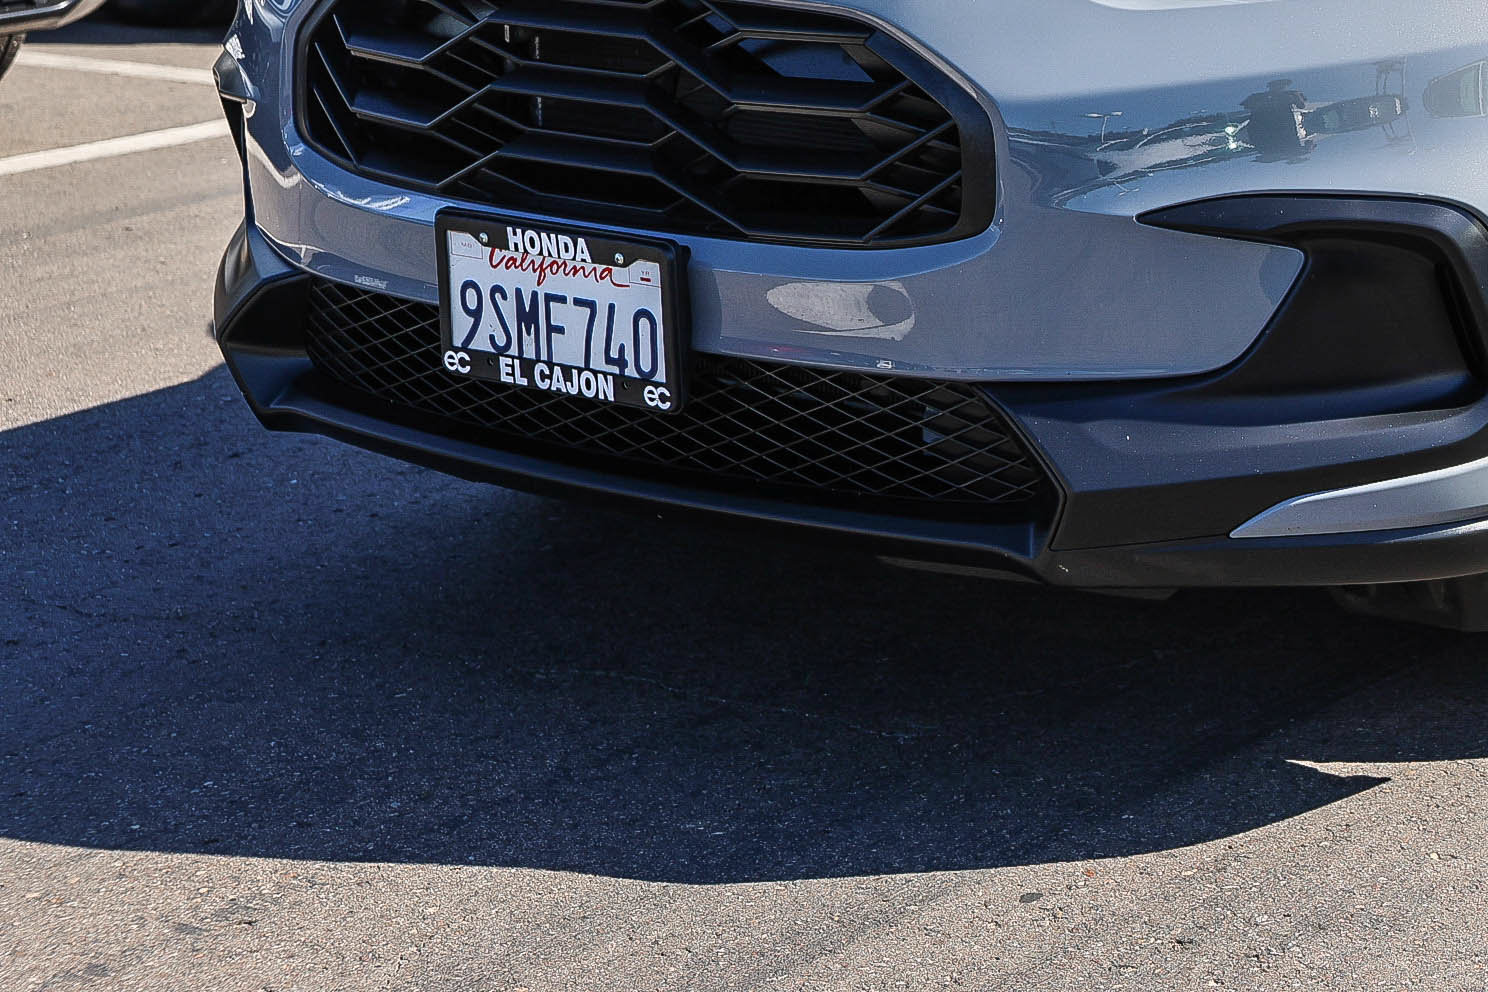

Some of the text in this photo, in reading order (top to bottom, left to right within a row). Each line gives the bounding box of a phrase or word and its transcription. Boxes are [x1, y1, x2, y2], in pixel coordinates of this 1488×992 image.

[506, 227, 592, 263] HONDA
[488, 247, 630, 287] California
[460, 280, 658, 380] 9SMF740
[499, 356, 615, 402] EL CAJON
